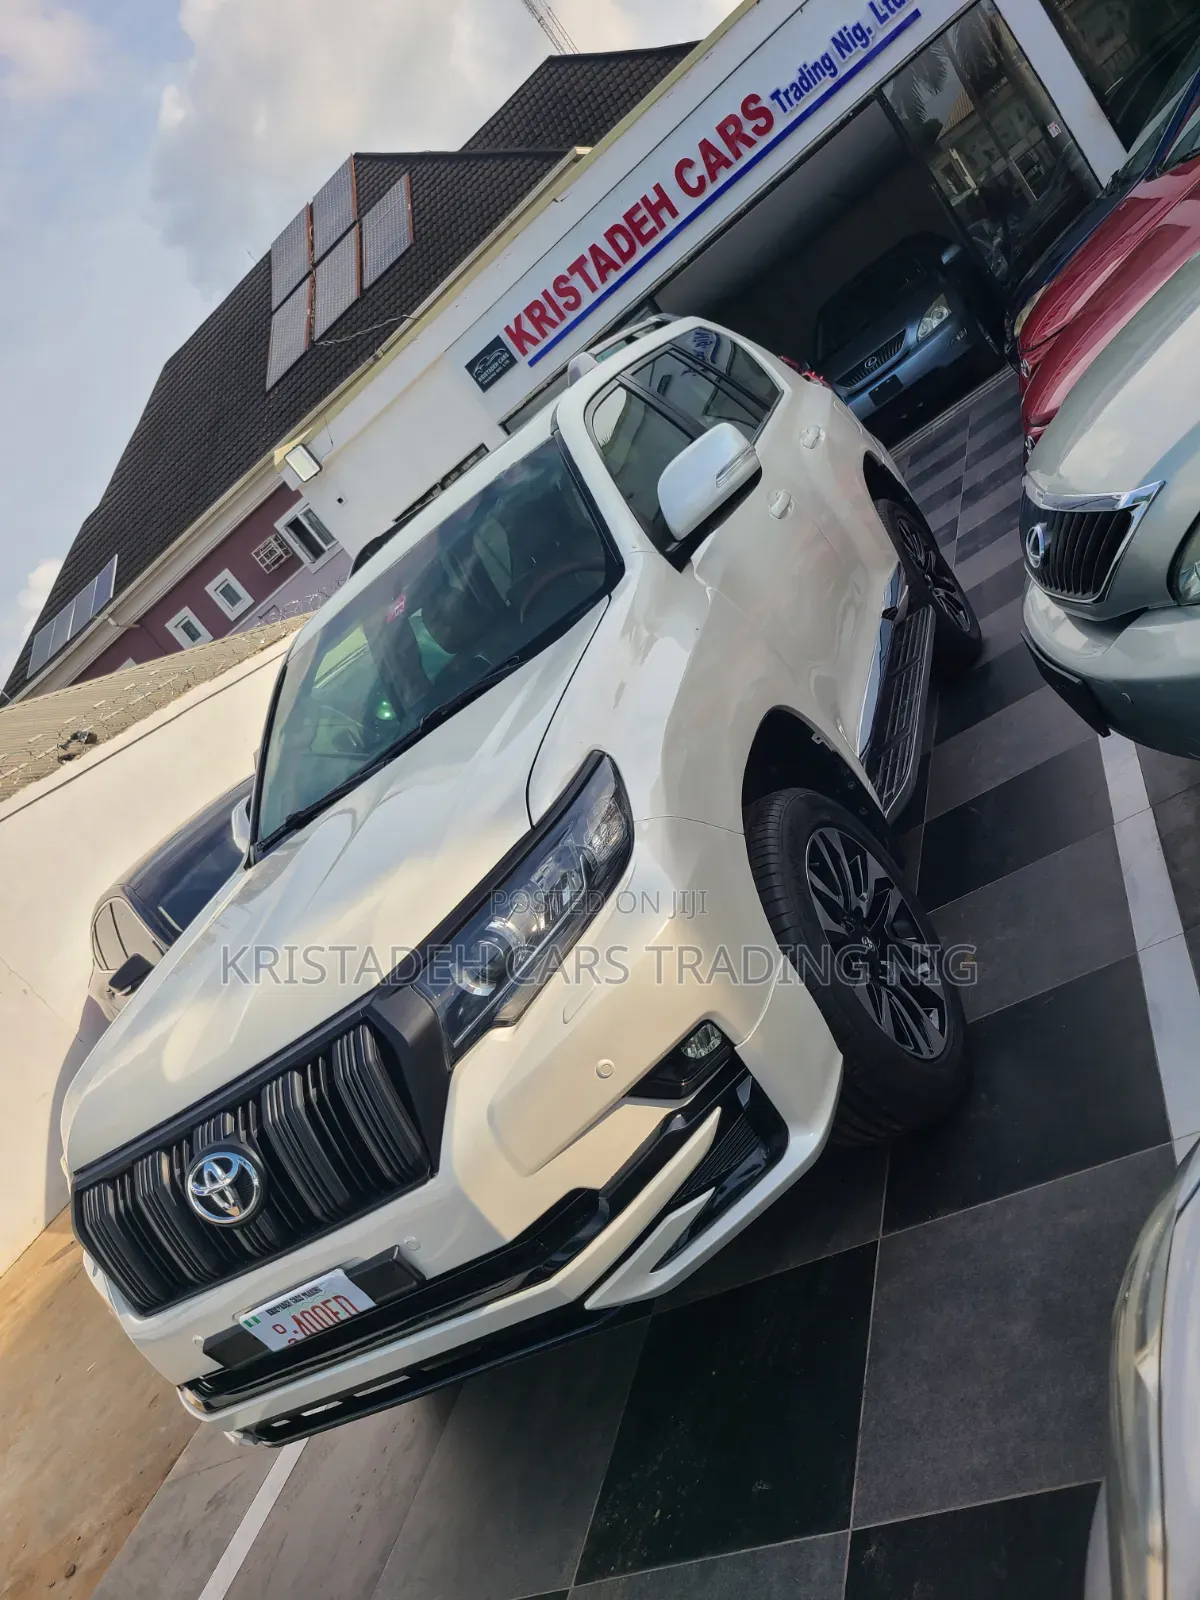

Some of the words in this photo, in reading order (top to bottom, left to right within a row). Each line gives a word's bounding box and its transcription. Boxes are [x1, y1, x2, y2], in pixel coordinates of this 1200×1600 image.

[504, 184, 676, 354] KRISTADEH
[674, 95, 774, 198] CARS
[768, 52, 838, 113] Trading
[830, 21, 873, 60] Nig.
